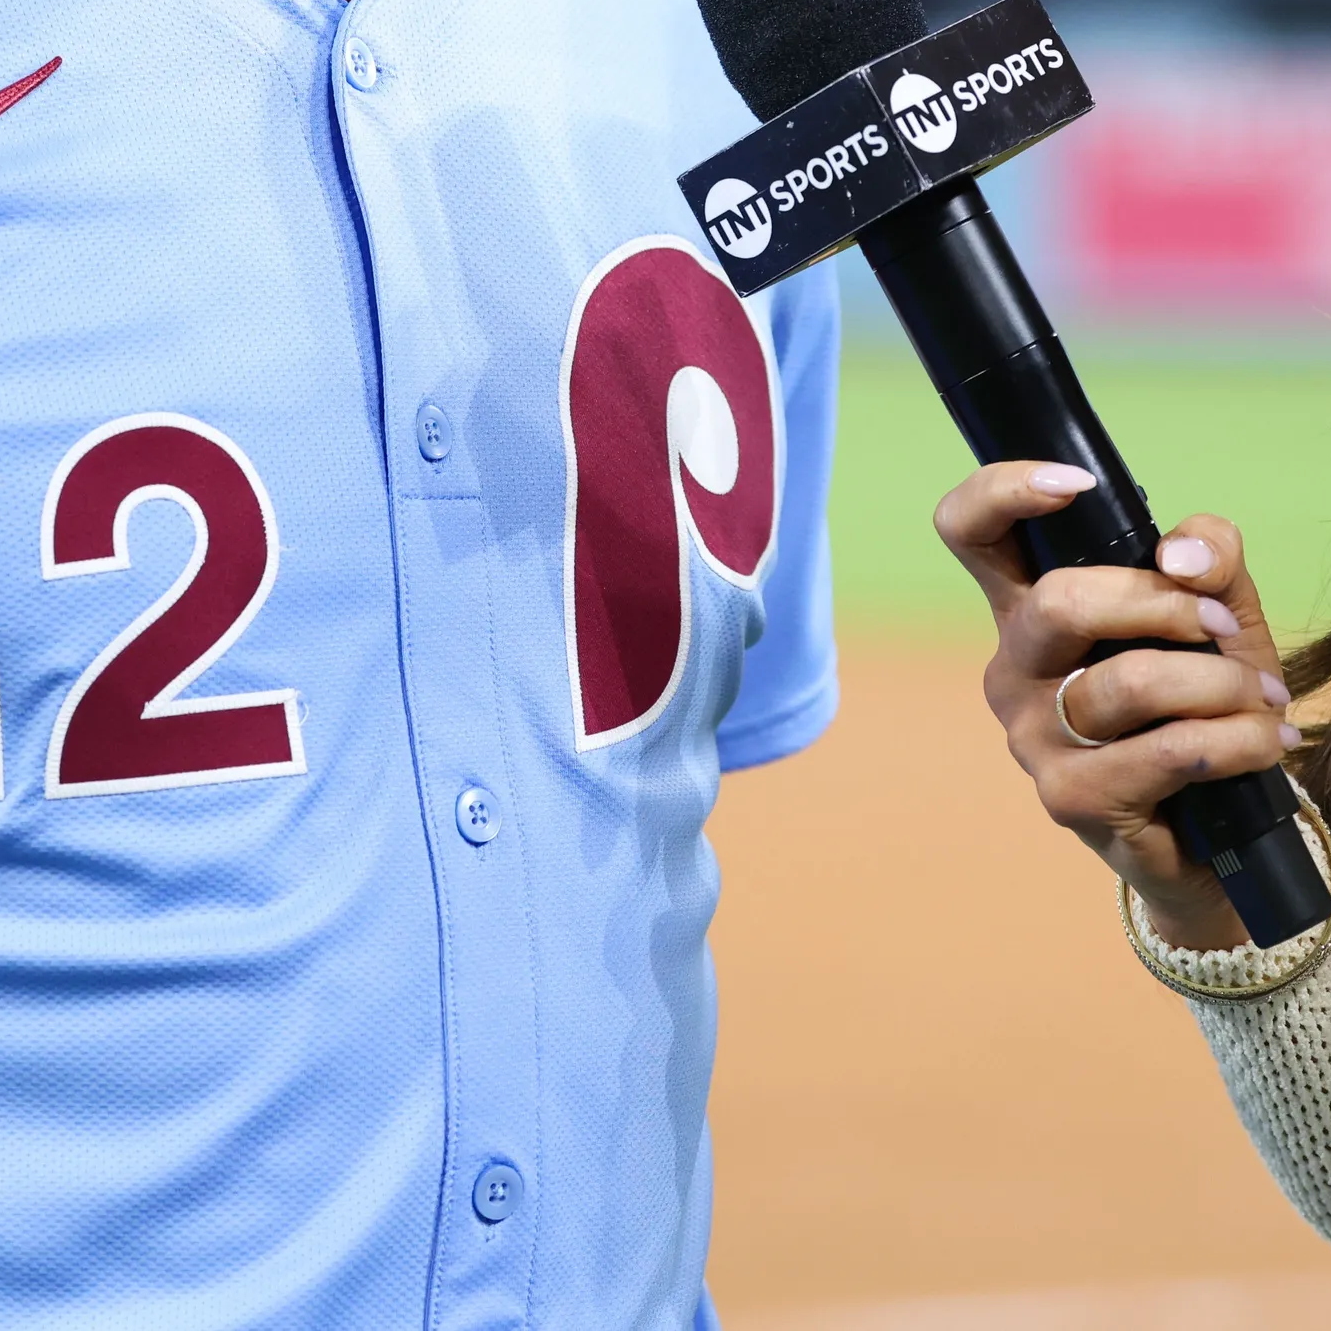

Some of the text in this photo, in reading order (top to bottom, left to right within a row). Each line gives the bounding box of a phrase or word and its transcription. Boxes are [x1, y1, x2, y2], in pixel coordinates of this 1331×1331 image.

[894, 38, 1065, 143] TNT SPORTS
[708, 124, 889, 247] TNT SPORTS
